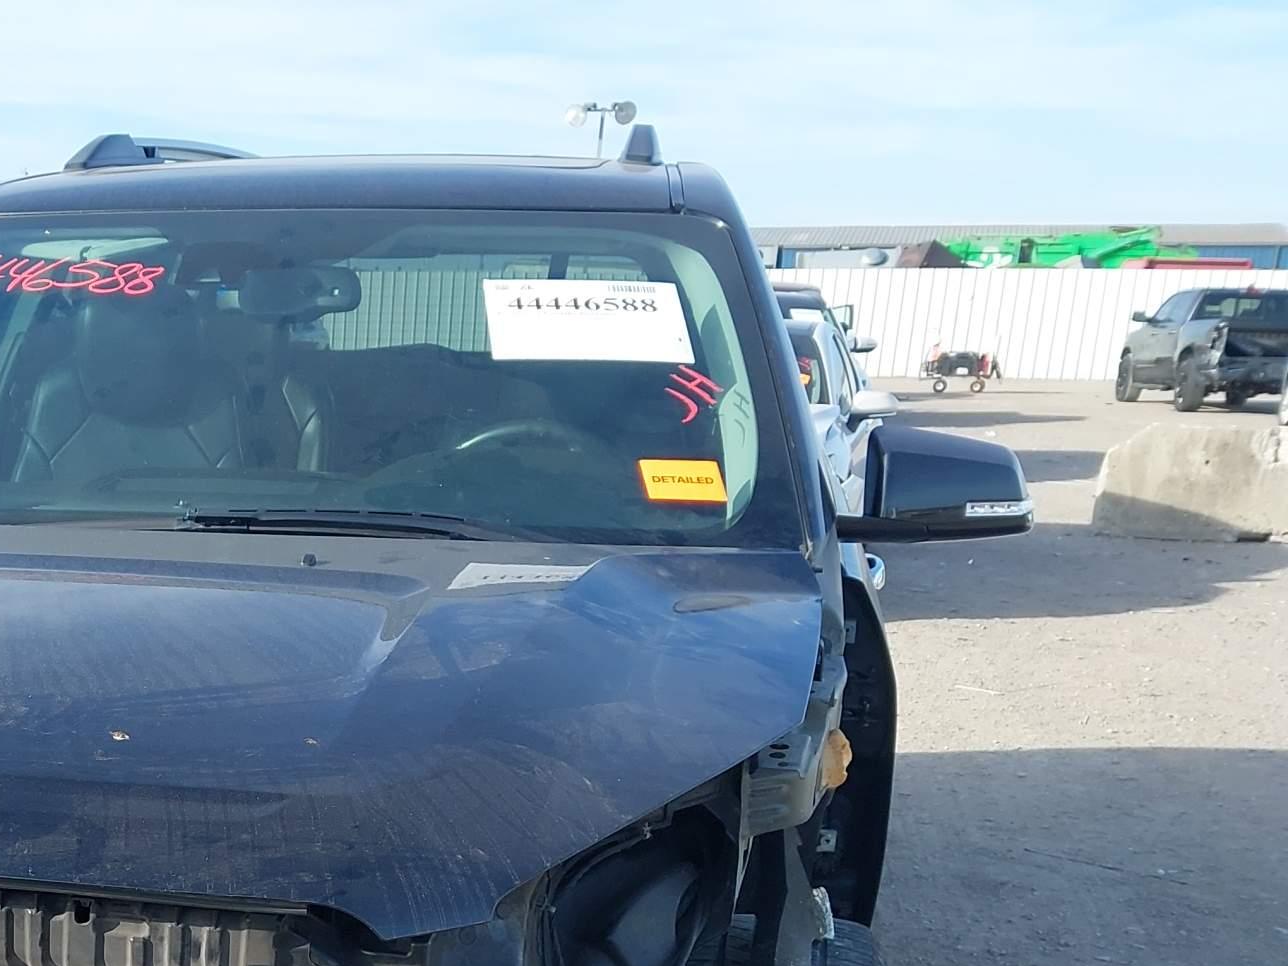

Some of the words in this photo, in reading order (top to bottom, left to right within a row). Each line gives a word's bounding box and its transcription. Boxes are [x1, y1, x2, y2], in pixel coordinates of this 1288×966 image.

[507, 296, 659, 313] 44446588
[663, 363, 724, 424] JH
[651, 475, 715, 485] DETAILED
